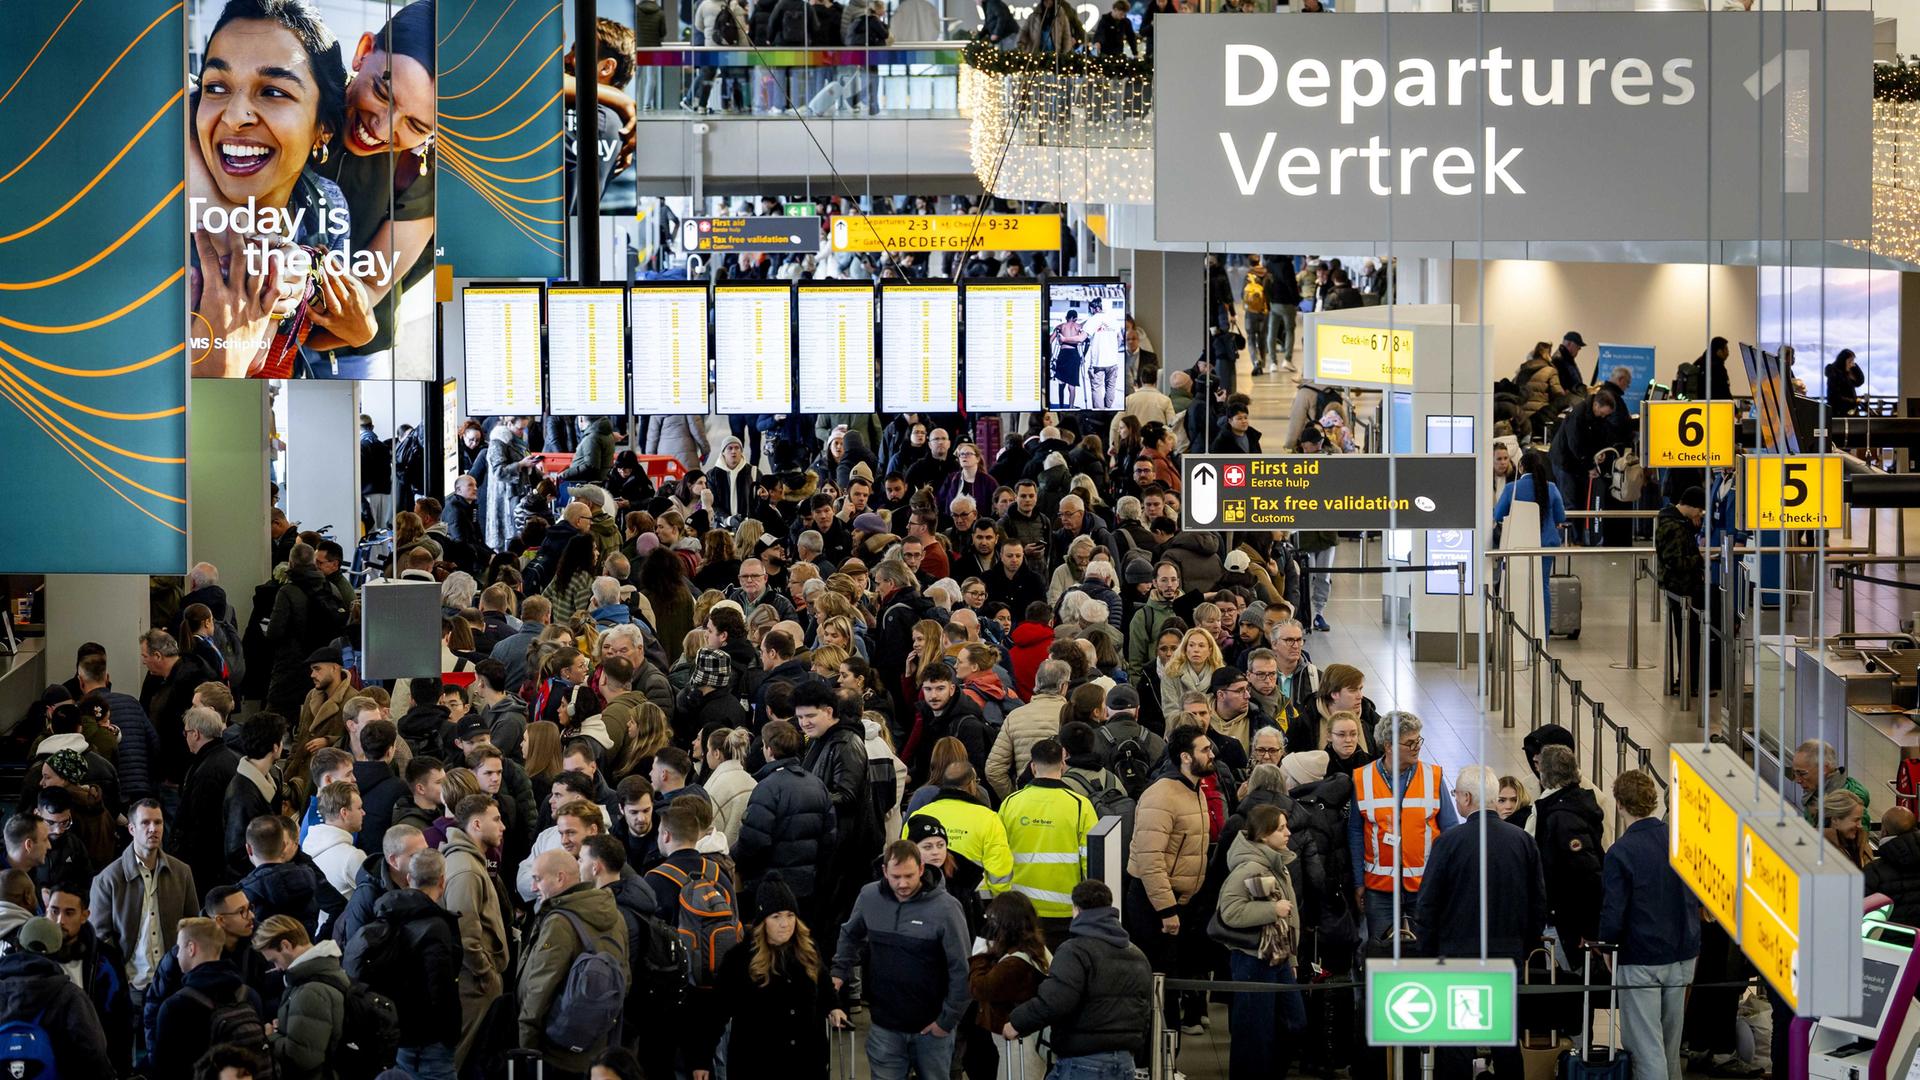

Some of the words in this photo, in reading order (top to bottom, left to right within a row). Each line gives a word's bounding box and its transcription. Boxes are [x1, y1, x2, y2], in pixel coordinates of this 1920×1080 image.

[1224, 43, 1695, 124] Departures
[568, 109, 577, 131] i
[1743, 49, 1810, 193] 1
[1219, 127, 1527, 195] Vertrek
[189, 196, 306, 243] Today
[318, 198, 349, 235] is
[712, 219, 731, 227] First
[732, 219, 746, 227] aid
[908, 220, 928, 230] 2-3
[989, 219, 1019, 230] 9-32
[243, 238, 312, 276] the
[324, 239, 401, 287] day
[214, 338, 271, 351] Schiphol
[1371, 334, 1377, 350] 6
[1382, 335, 1388, 351] 7
[1393, 336, 1399, 352] 8
[1678, 407, 1704, 447] 6
[1677, 452, 1721, 461] Check-in
[1251, 461, 1284, 475] First
[1287, 461, 1319, 475] aid
[1251, 478, 1283, 488] Eerste
[1286, 478, 1310, 489] hulp
[1781, 463, 1808, 507] 5
[1251, 496, 1279, 510] Tax
[1283, 496, 1318, 510] free
[1321, 496, 1409, 510] validation
[1251, 513, 1295, 523] Customs
[1779, 513, 1827, 523] Check-in
